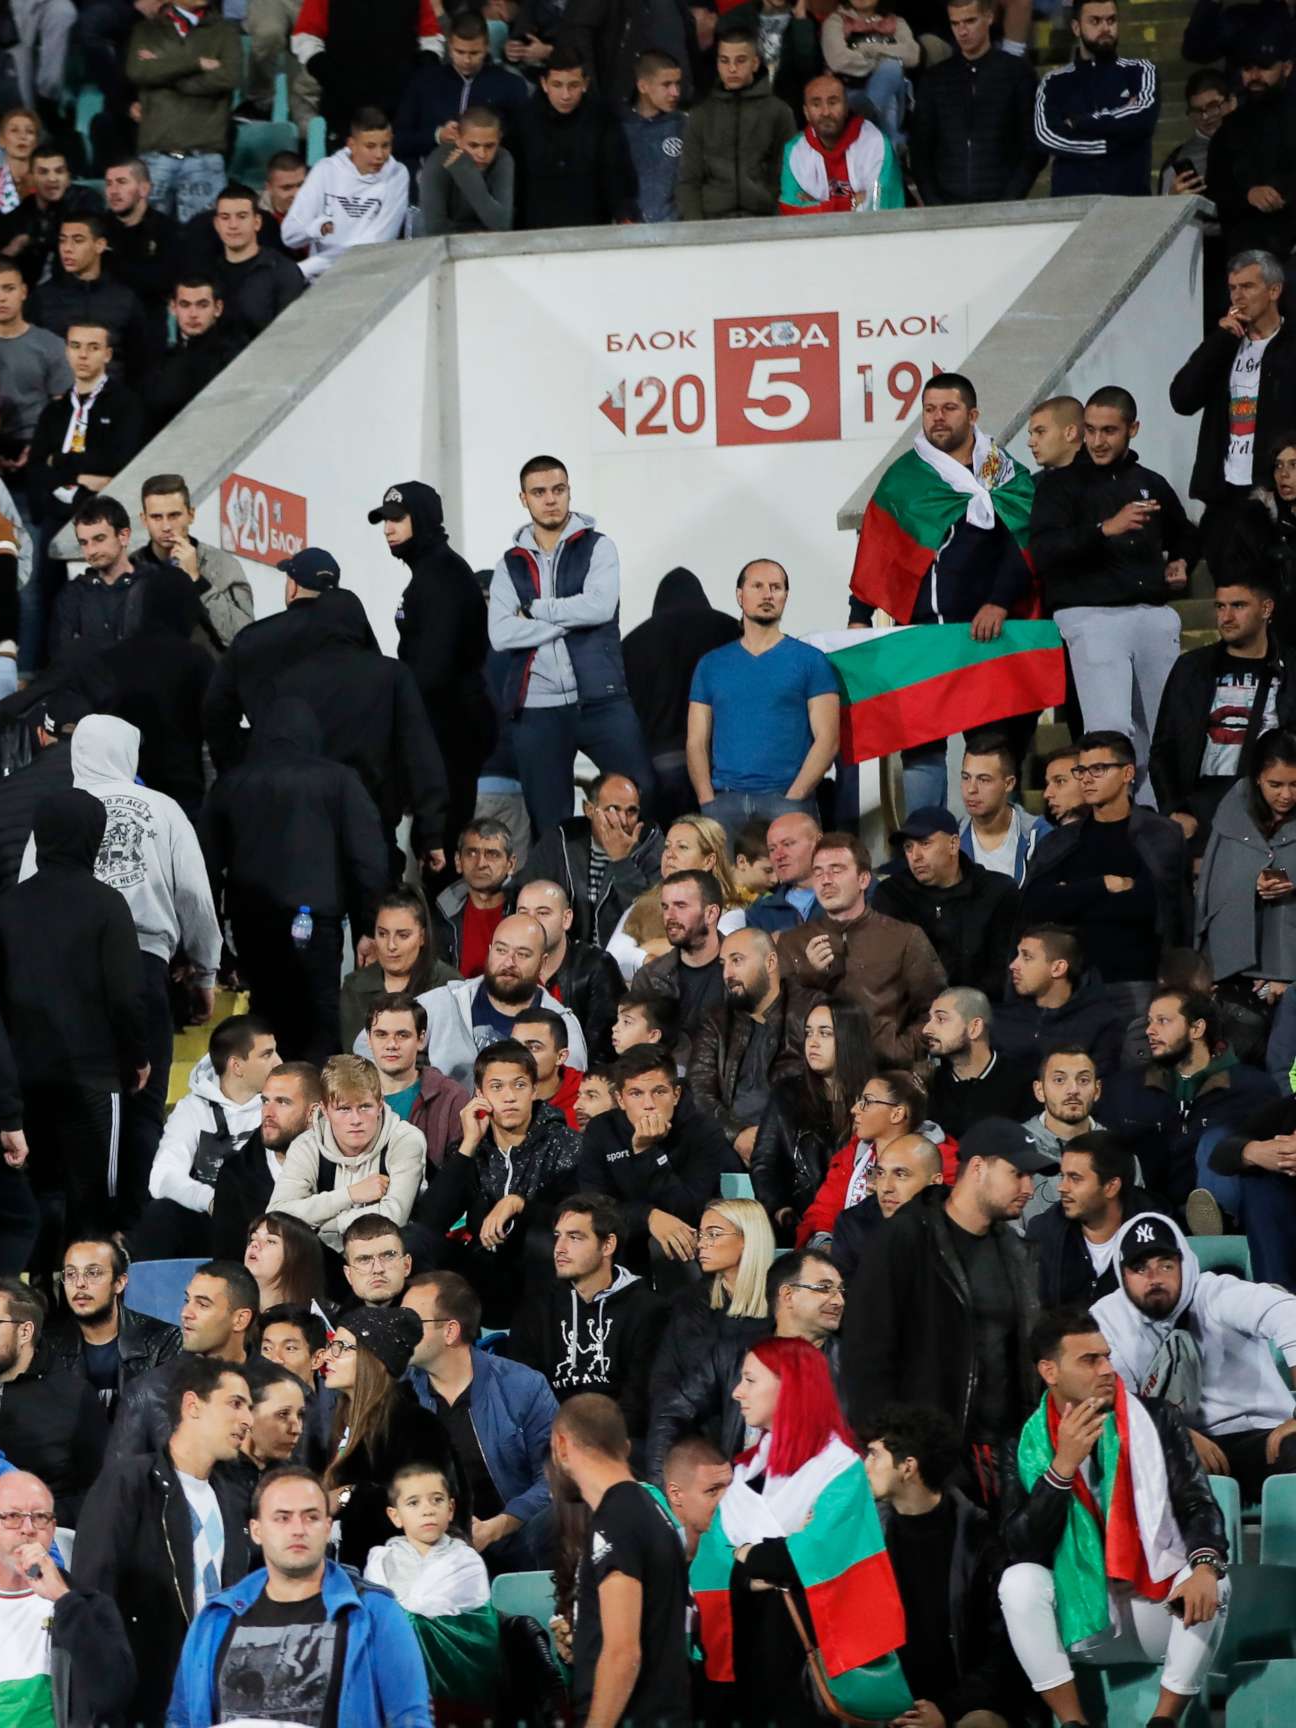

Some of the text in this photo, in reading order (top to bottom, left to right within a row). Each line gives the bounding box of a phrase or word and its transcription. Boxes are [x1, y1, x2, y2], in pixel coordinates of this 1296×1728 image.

[728, 321, 830, 349] ВХОД
[856, 315, 949, 338] БЛОК
[607, 330, 696, 352] БЛОК
[634, 374, 706, 436] 20
[742, 357, 811, 432] 5
[857, 361, 922, 422] 19
[239, 486, 270, 556] 20
[270, 527, 304, 555] БЛОК
[119, 872, 141, 886] HERE
